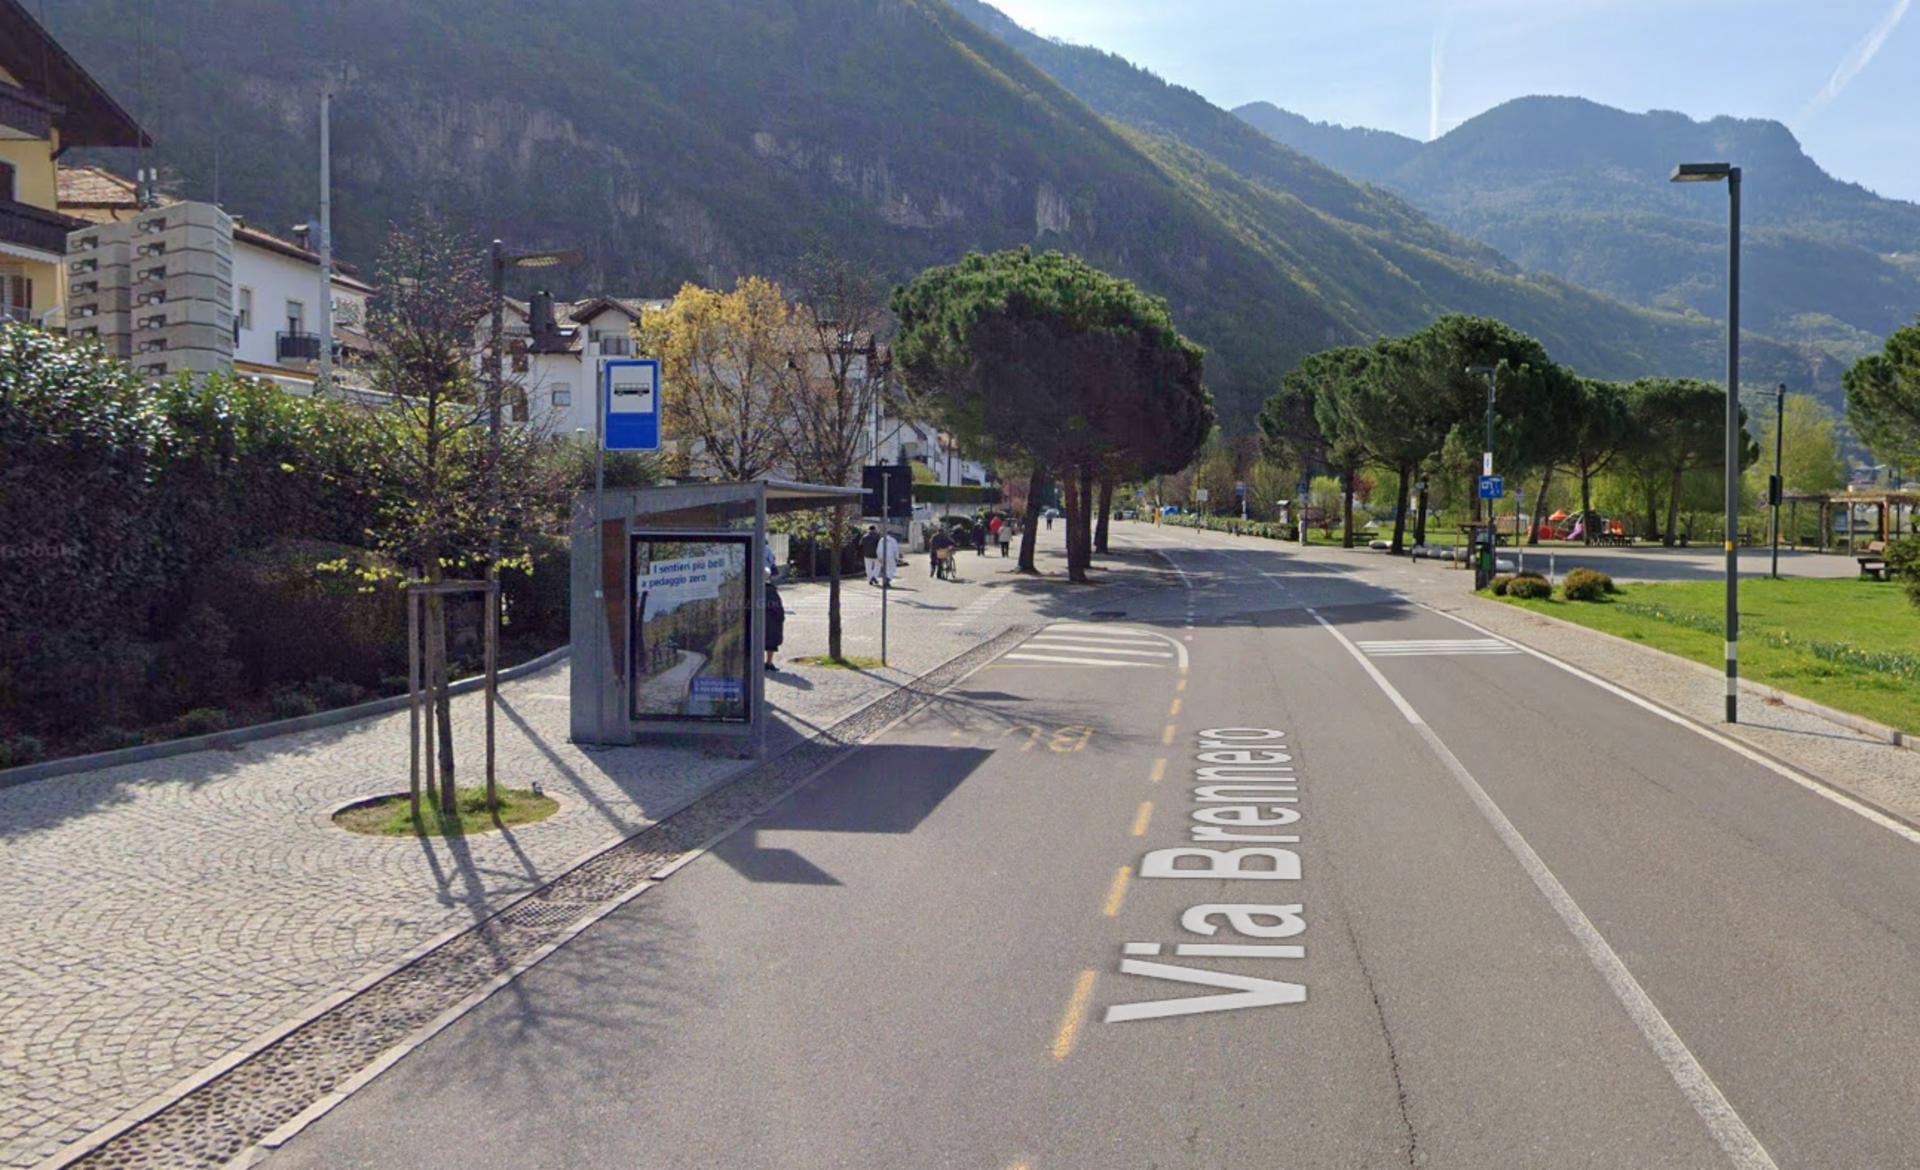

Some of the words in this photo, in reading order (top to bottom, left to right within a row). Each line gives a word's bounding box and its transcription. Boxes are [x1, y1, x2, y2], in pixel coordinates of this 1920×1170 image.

[659, 563, 691, 574] sentieri
[692, 559, 706, 571] più
[649, 575, 687, 588] pedaggio
[689, 574, 707, 583] zero
